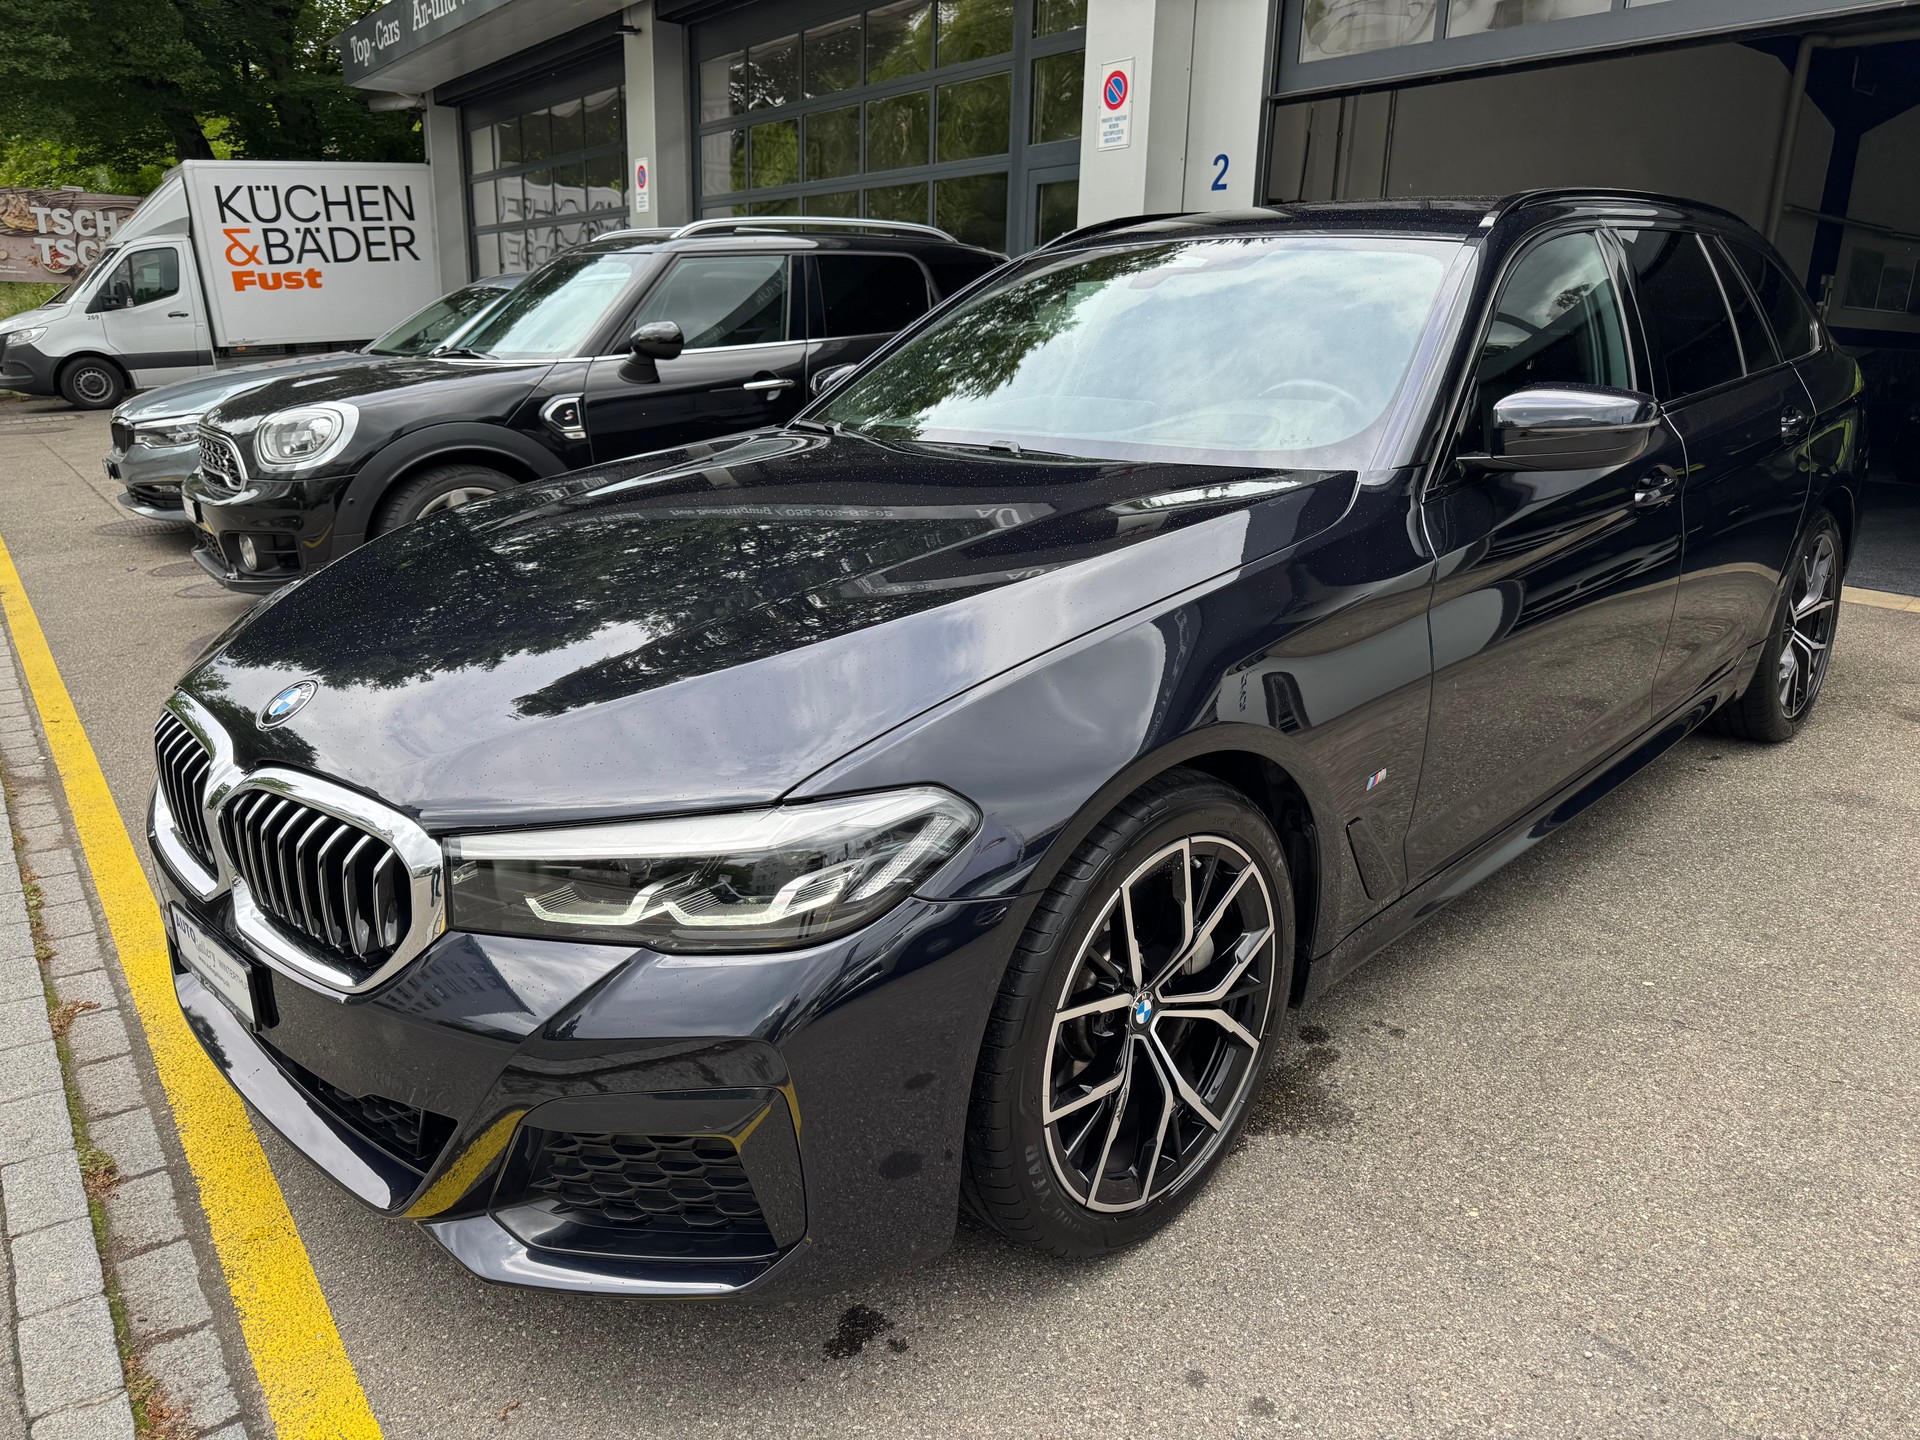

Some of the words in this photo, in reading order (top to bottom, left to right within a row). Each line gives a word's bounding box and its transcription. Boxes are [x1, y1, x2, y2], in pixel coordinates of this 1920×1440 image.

[1210, 153, 1230, 191] 2
[214, 184, 415, 224] KÜCHEN
[33, 237, 107, 267] TSC
[231, 268, 323, 292] Fust
[175, 913, 197, 944] AUTO
